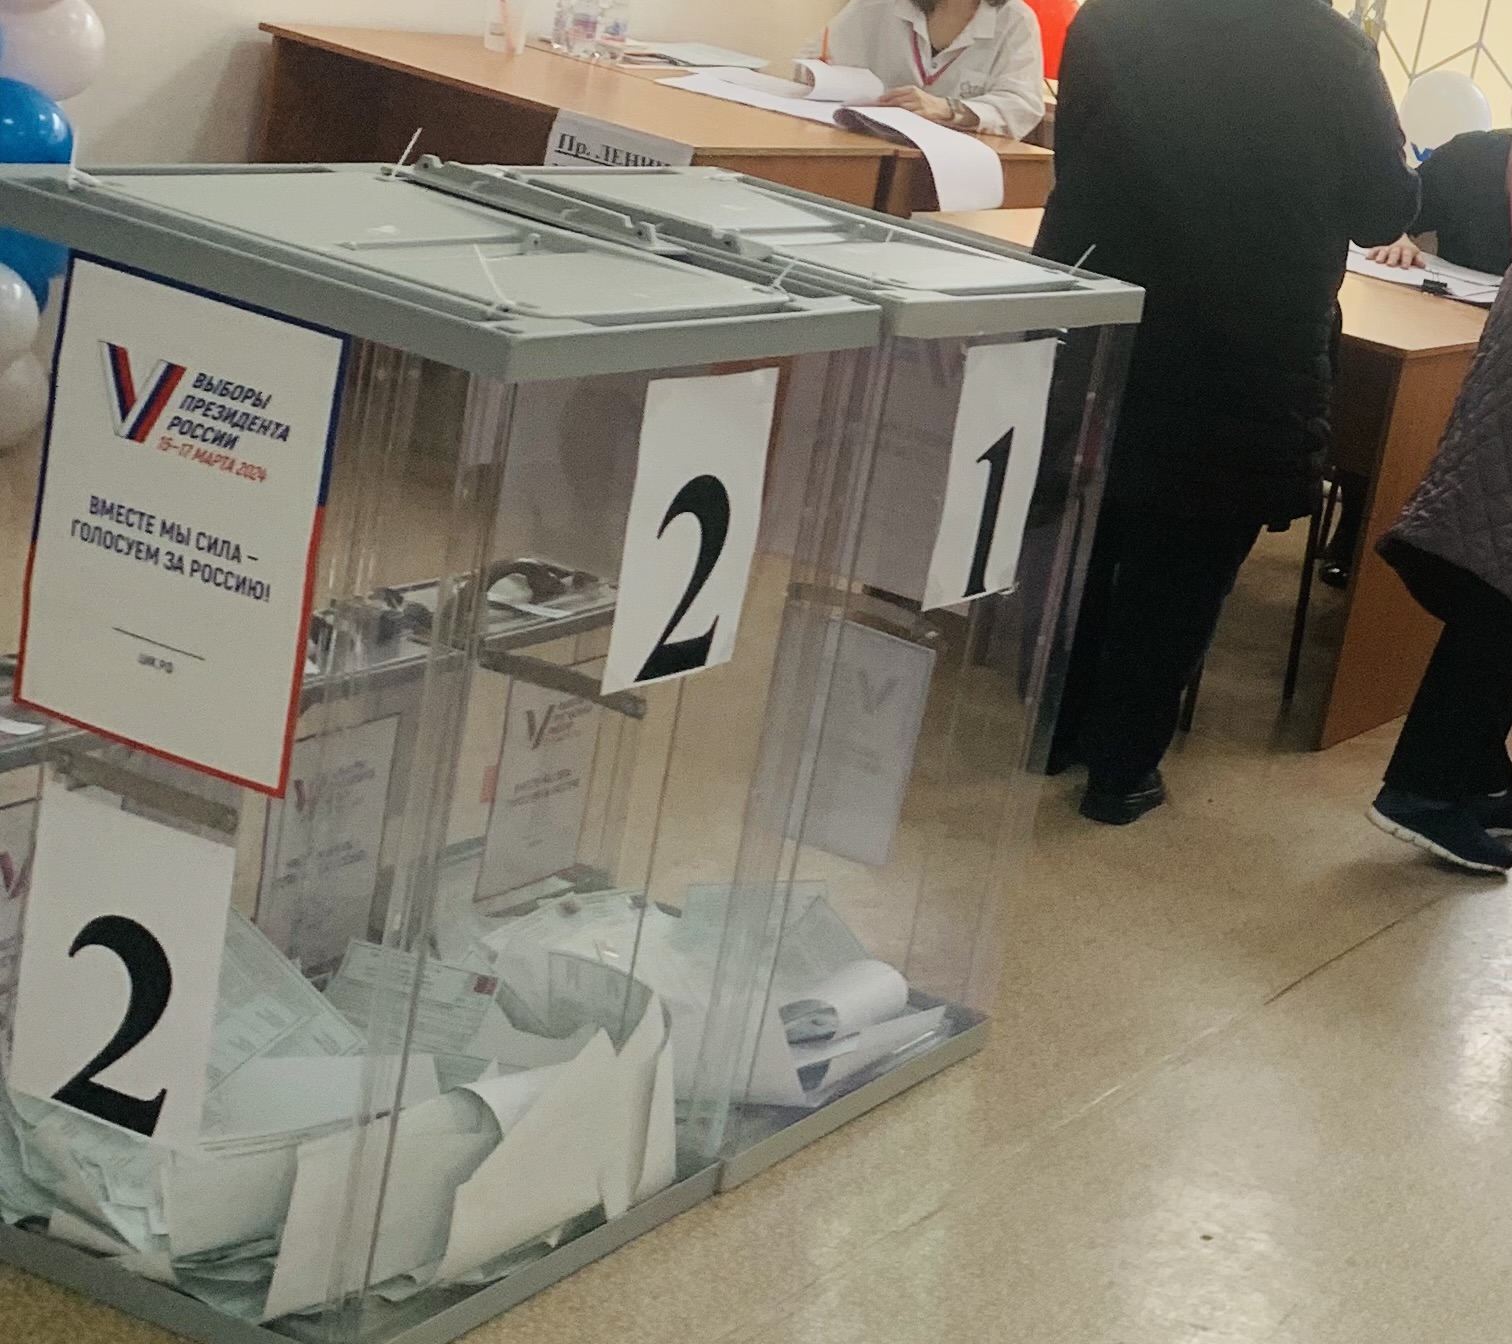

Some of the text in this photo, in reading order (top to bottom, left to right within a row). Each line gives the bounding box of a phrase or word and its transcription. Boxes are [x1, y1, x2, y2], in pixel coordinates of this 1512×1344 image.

[179, 395, 292, 442] ПРЕЗИДЕНТА
[192, 373, 272, 410] ВЫБОРЫ
[166, 416, 240, 450] РОССИИ
[191, 447, 236, 473] МАРТА
[235, 462, 268, 483] 2024
[89, 495, 156, 535] ВМЕСТЕ
[160, 519, 191, 546] МЫ
[196, 531, 242, 564] СИЛА
[961, 426, 1015, 598] 1
[71, 518, 271, 603] ГОЛОСУЕМ ЗА РОССИЮ!
[632, 474, 730, 682] 2
[50, 914, 172, 1137] 2
